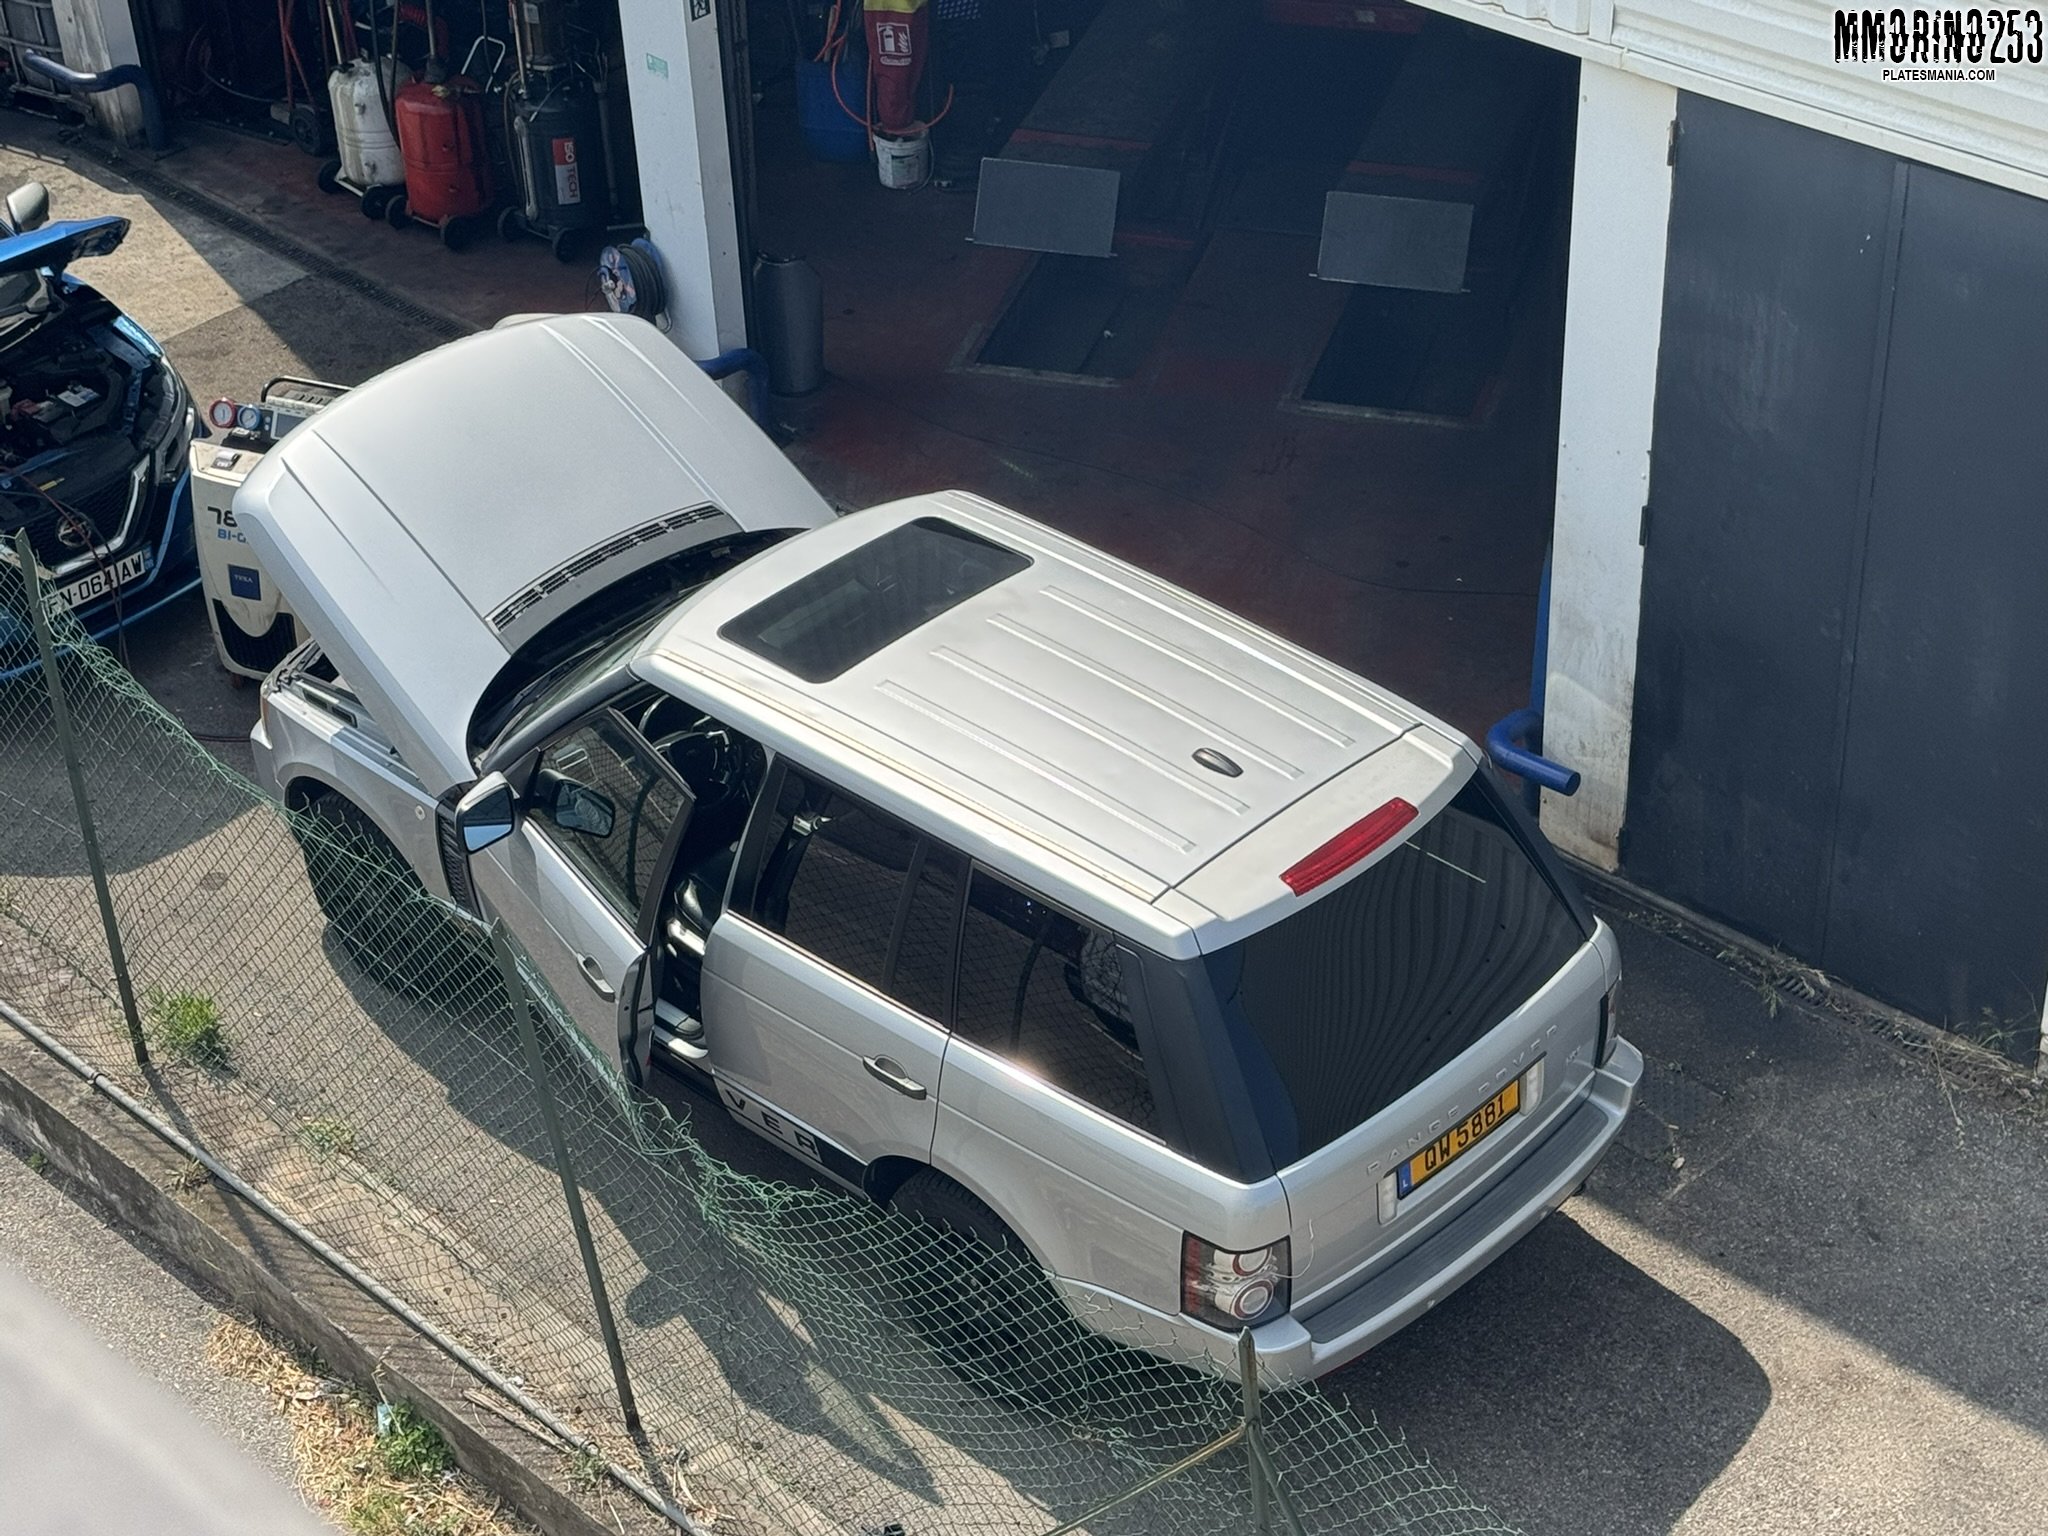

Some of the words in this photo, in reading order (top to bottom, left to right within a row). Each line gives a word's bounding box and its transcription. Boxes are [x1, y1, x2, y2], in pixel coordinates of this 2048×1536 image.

[567, 165, 578, 198] TECH
[217, 528, 249, 544] BI-G
[1366, 1105, 1460, 1176] RANGE
[1478, 1024, 1558, 1093] ROVER
[1424, 1133, 1451, 1171] QW
[1456, 1094, 1504, 1147] 5881
